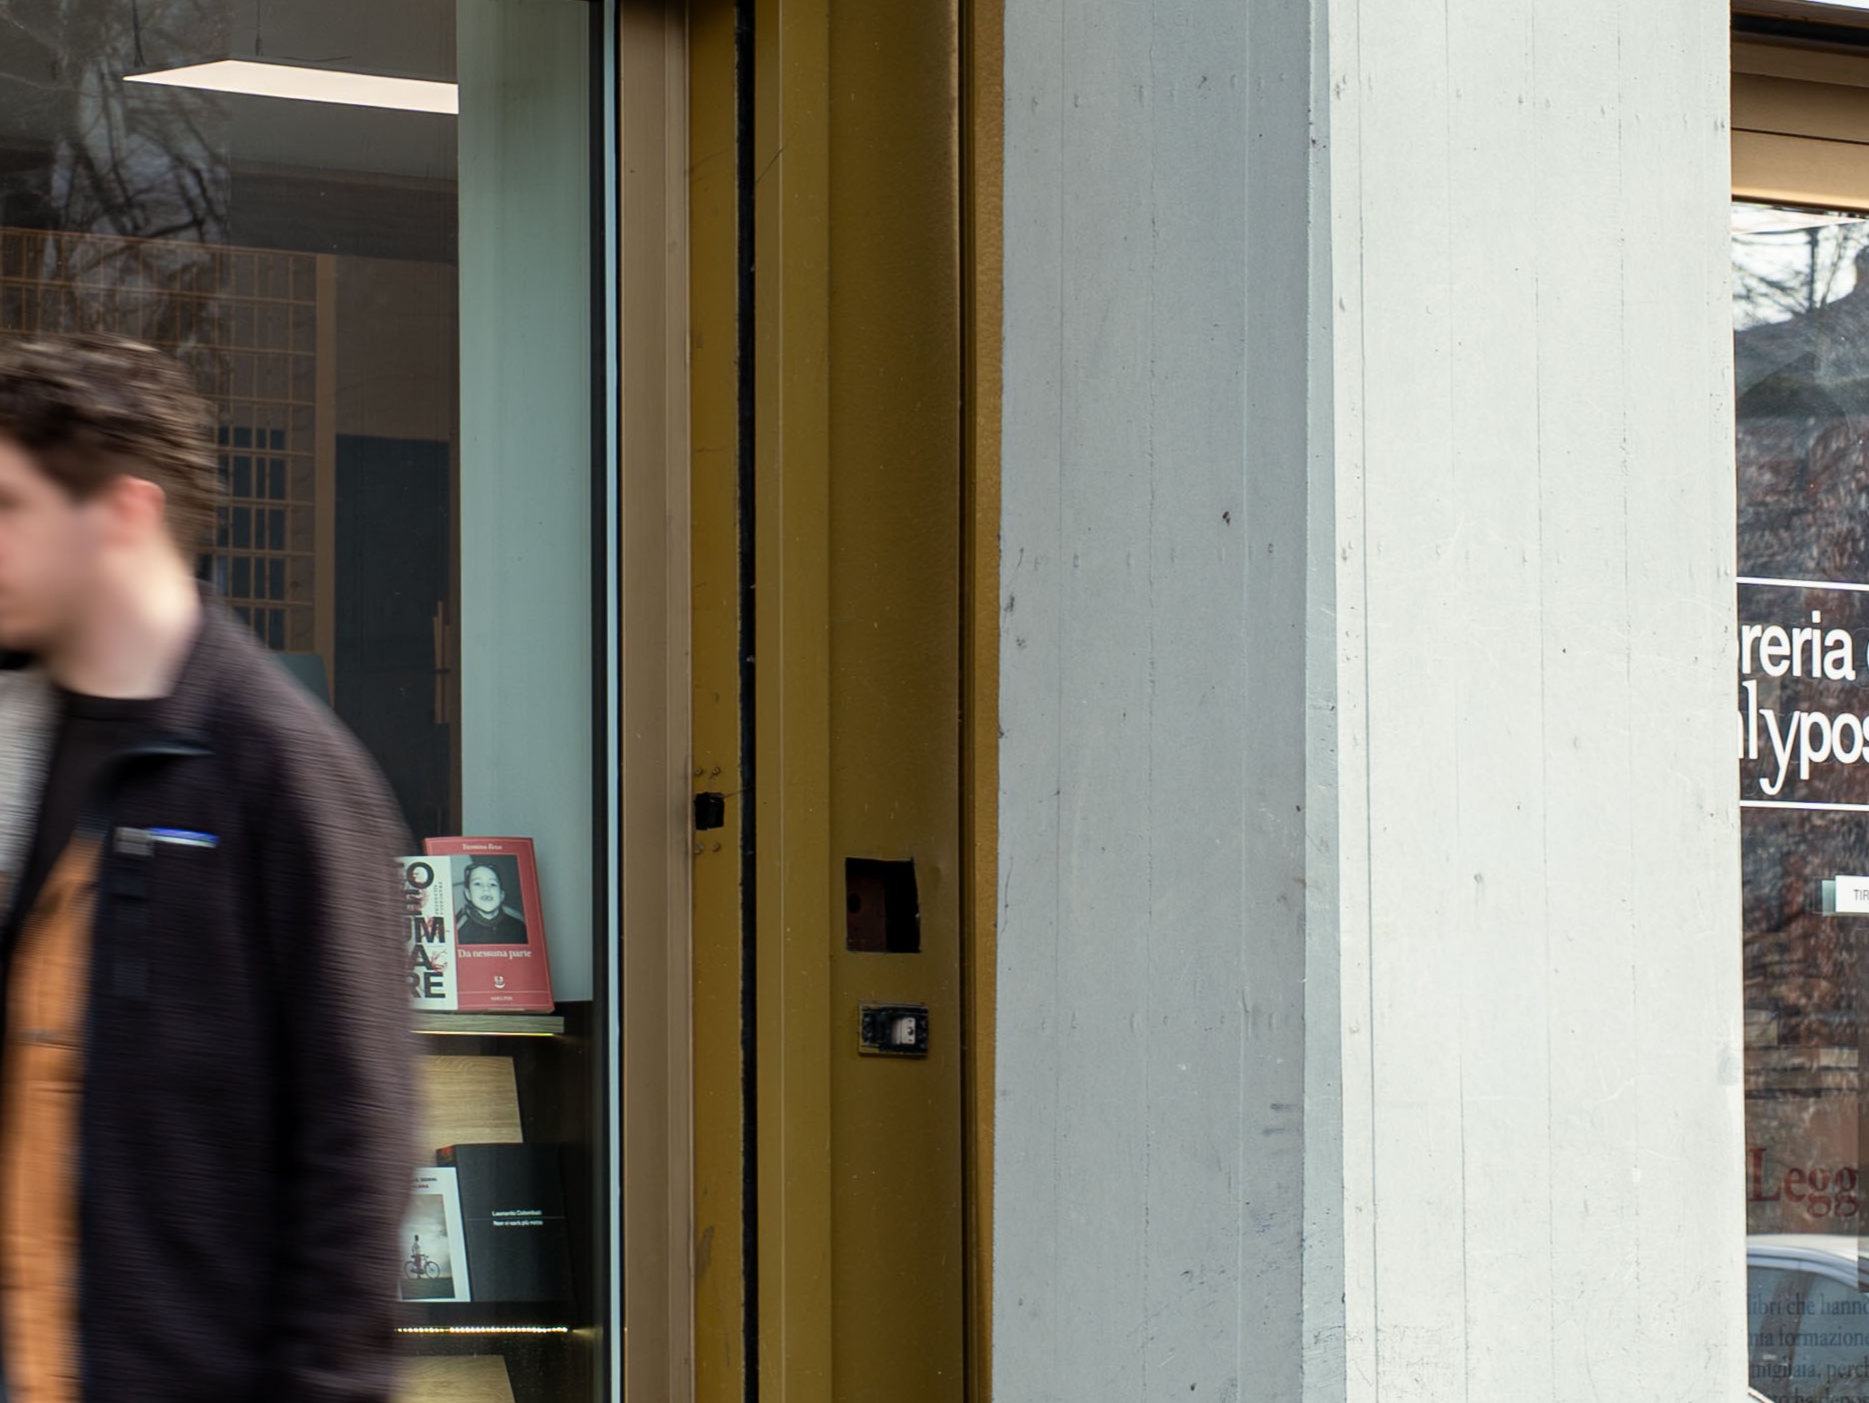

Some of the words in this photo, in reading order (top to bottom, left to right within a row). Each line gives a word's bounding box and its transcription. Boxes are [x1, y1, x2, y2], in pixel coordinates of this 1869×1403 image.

[458, 949, 471, 959] Da
[473, 950, 508, 959] nessuna
[509, 949, 533, 960] parte
[1786, 1292, 1815, 1316] che
